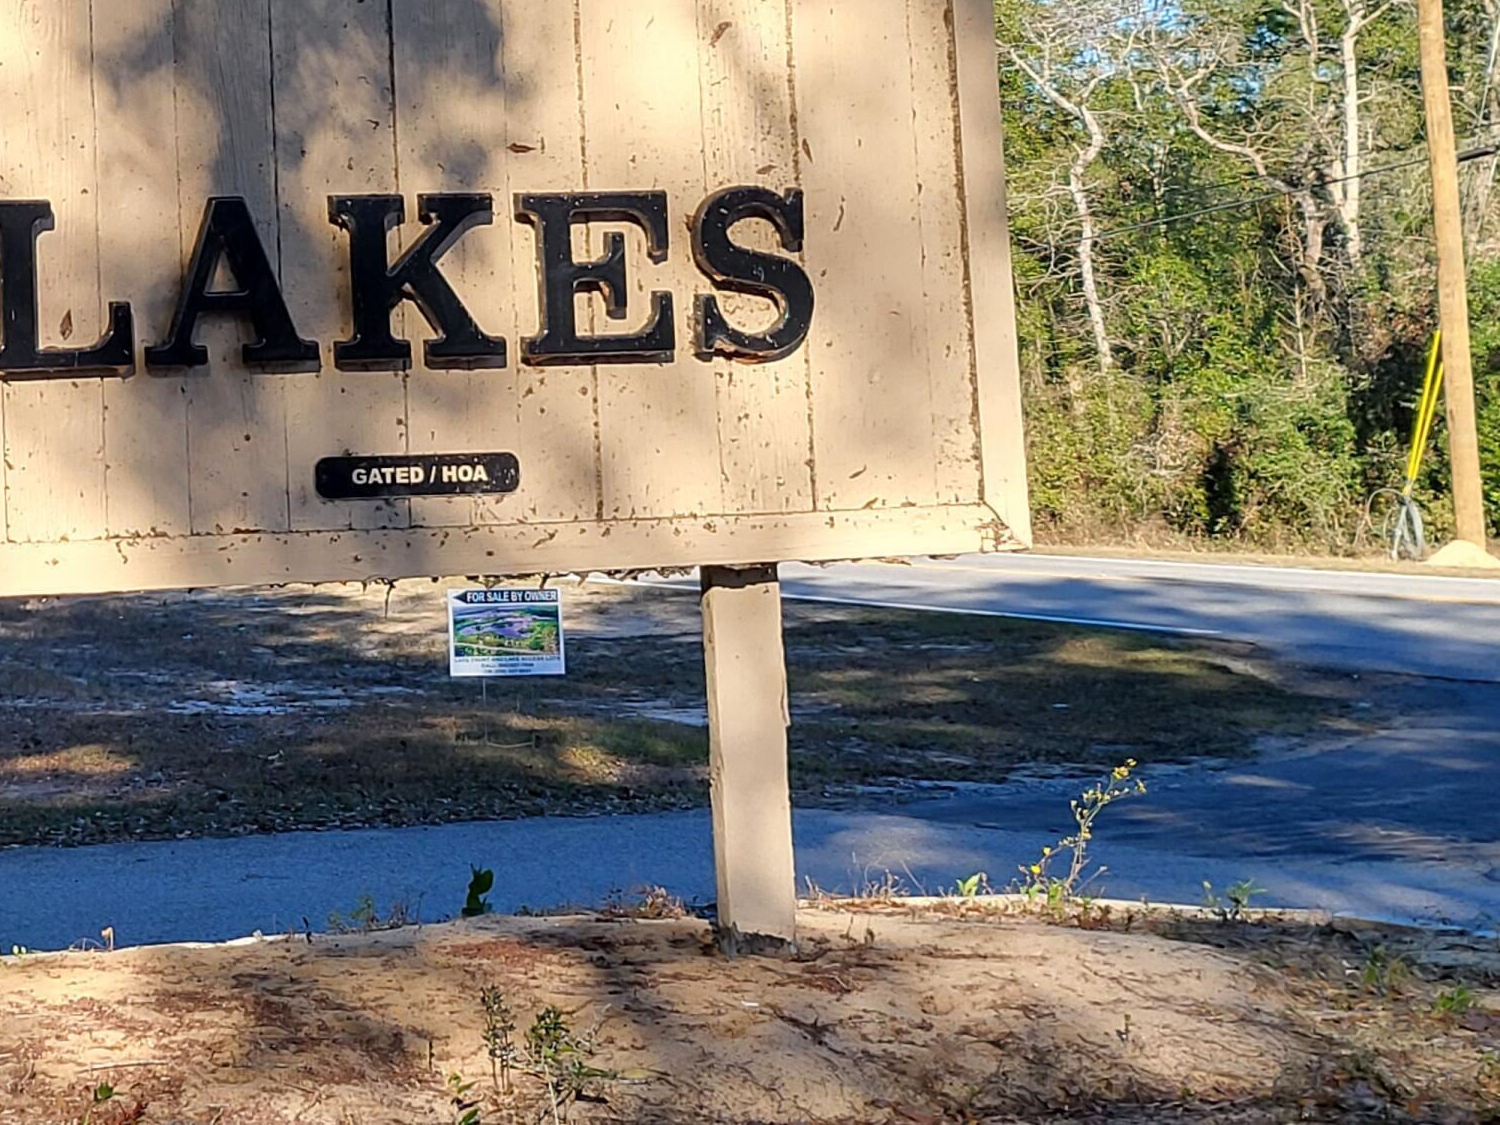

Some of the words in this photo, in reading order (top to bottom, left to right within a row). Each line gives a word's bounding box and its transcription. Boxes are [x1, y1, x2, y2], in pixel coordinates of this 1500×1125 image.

[351, 465, 425, 485] GATED
[429, 464, 437, 484] /
[441, 463, 489, 483] HOA
[466, 592, 485, 602] FOR
[486, 591, 509, 602] SALE
[510, 591, 523, 602] BY
[524, 590, 557, 601] OWNER
